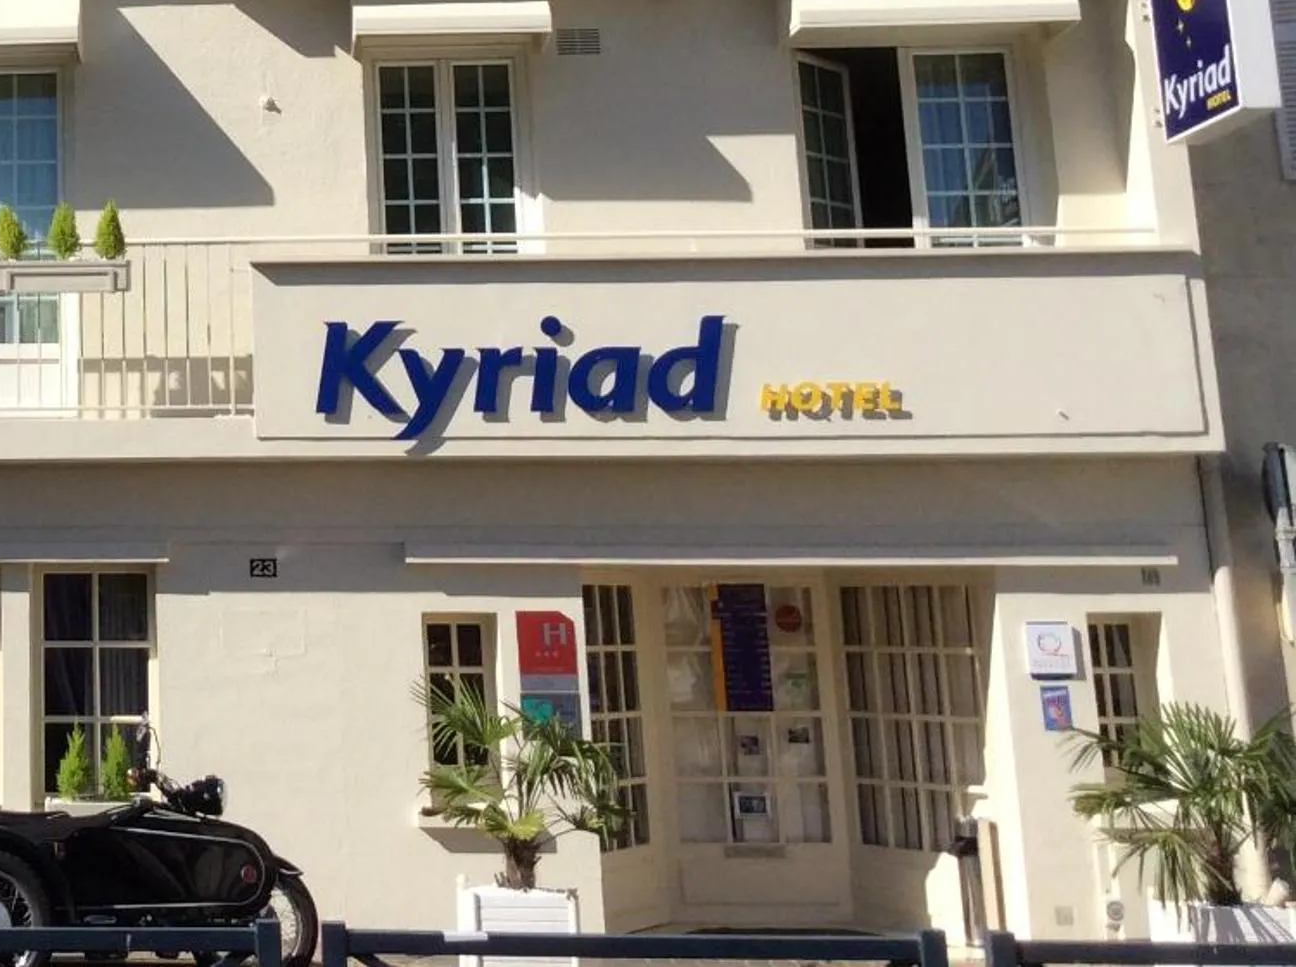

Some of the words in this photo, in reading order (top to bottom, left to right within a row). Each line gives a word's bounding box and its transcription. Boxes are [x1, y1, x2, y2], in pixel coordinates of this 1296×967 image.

[1164, 44, 1232, 120] Kyriad
[316, 316, 726, 440] Kyriad
[760, 380, 903, 412] HOTEL
[251, 560, 274, 575] 23
[542, 622, 567, 646] H
